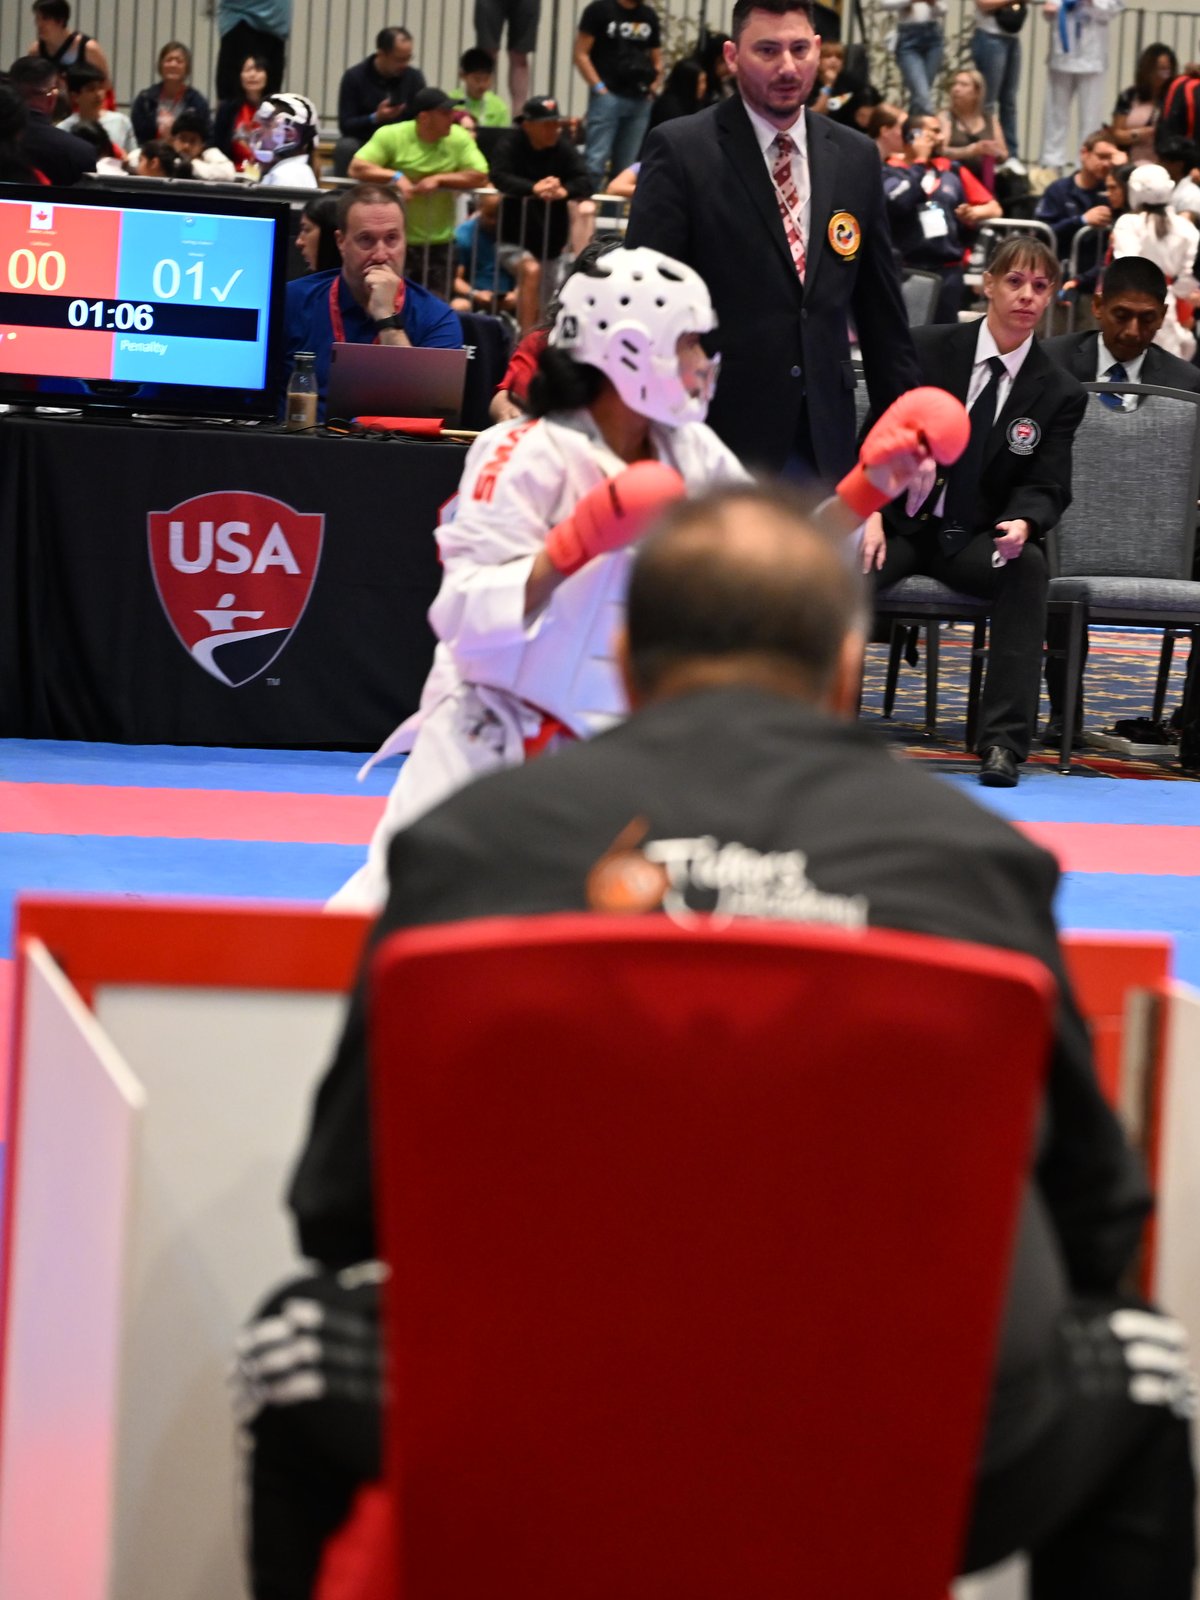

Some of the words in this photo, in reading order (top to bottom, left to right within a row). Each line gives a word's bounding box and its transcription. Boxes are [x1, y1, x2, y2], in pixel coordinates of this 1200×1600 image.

[8, 249, 66, 291] 00
[153, 258, 204, 300] 01
[68, 300, 154, 331] 01:06
[120, 339, 168, 356] Penalty
[169, 521, 302, 574] USA
